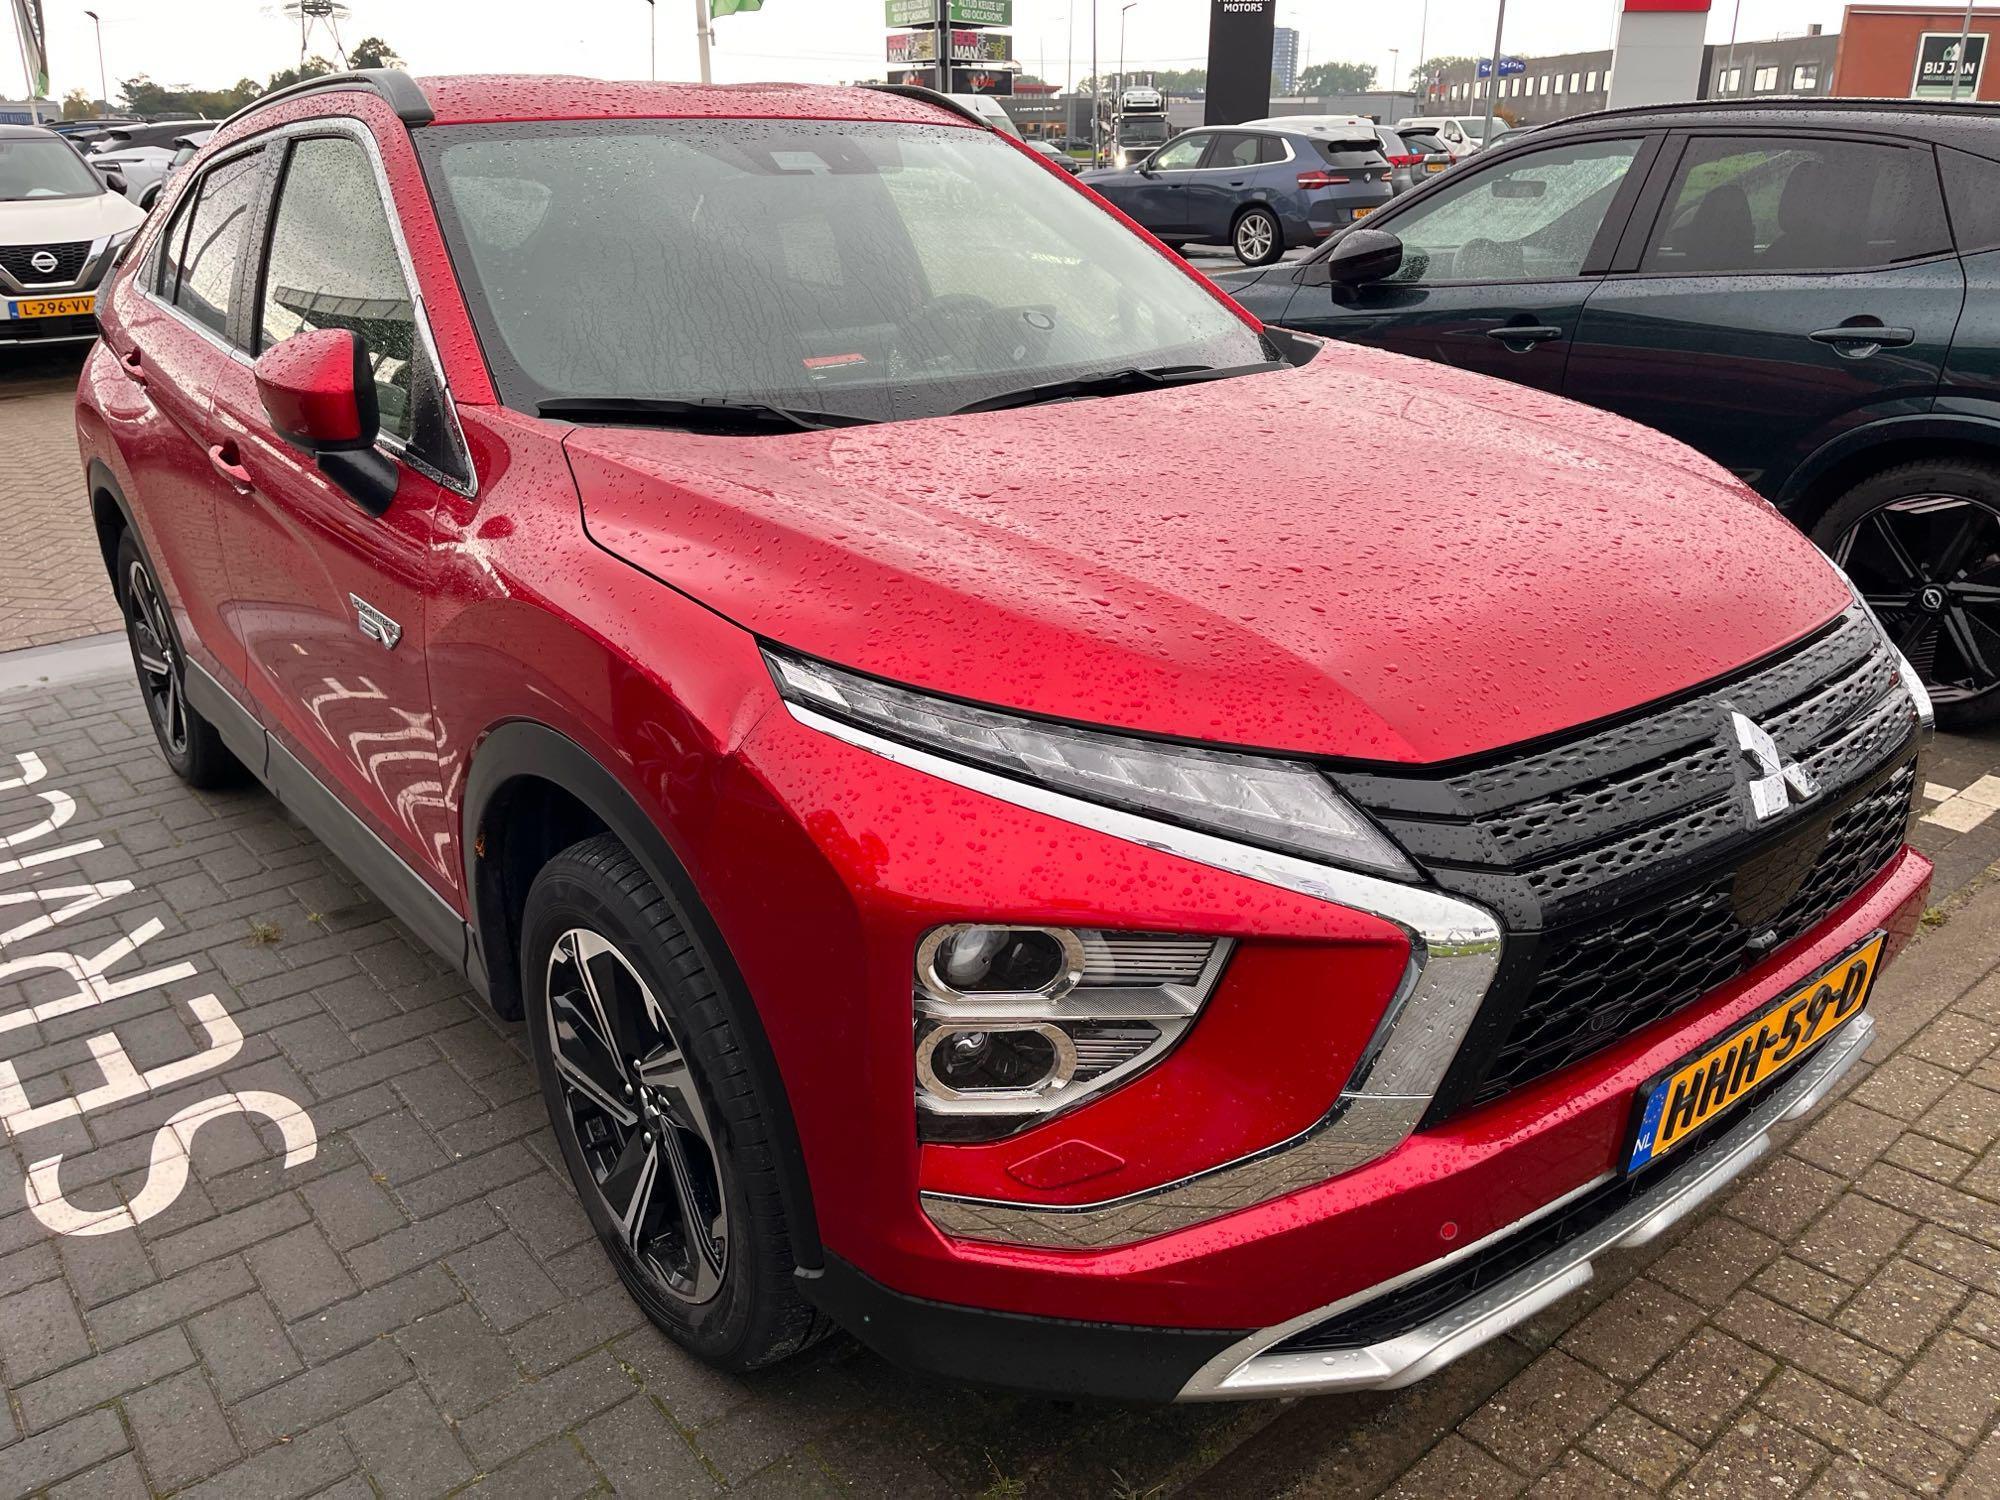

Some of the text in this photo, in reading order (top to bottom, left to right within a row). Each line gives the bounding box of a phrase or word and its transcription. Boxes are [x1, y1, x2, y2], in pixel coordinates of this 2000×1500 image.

[1223, 3, 1263, 12] MOTORS
[972, 10, 1003, 22] OCCASIONS
[954, 45, 978, 60] MAN
[1923, 62, 1945, 74] BIJ
[24, 300, 90, 316] L-296-VV
[1662, 959, 1868, 1141] HHH-59-D
[1633, 1132, 1652, 1155] NL
